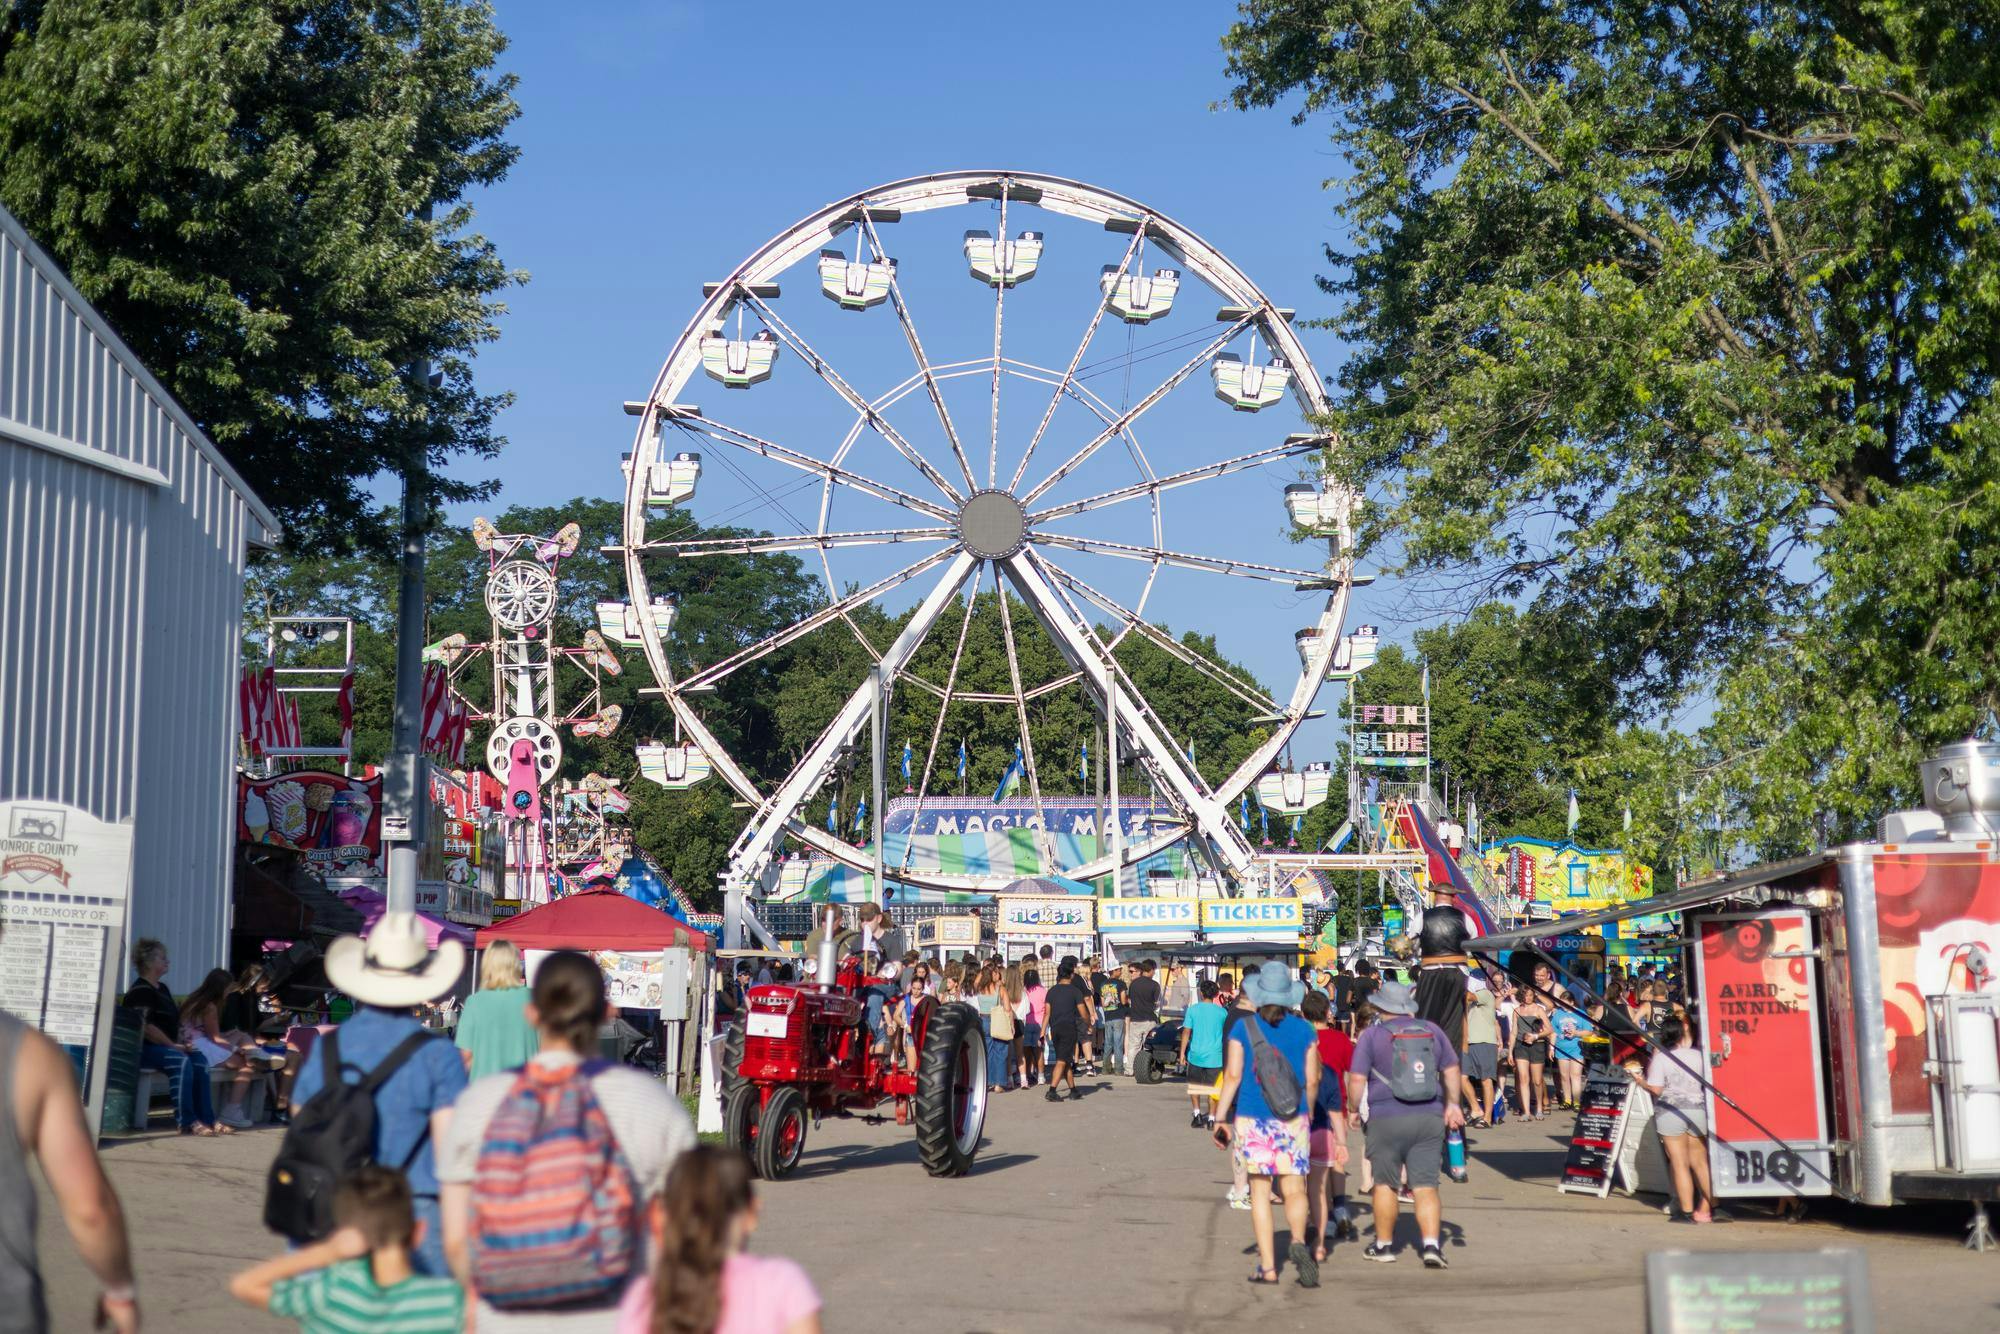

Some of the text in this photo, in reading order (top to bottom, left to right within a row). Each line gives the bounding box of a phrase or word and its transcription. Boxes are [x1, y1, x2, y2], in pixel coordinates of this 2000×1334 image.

[1024, 232, 1034, 241] 9
[1160, 269, 1174, 279] 10
[758, 332, 768, 342] 7
[1273, 358, 1284, 367] 11
[680, 453, 690, 462] 6
[654, 597, 664, 605] 5
[1358, 627, 1373, 636] 13
[1363, 705, 1418, 725] FUN
[1355, 731, 1424, 752] SLIDE
[1309, 762, 1324, 772] 14
[444, 822, 462, 836] CE
[0, 839, 79, 857] ONROE COUNTY
[307, 846, 368, 861] COTTON CANDY
[443, 838, 471, 855] EAM
[790, 852, 800, 860] 3
[1524, 861, 1533, 893] TOWN
[423, 893, 438, 905] POP
[12, 905, 29, 916] OR
[32, 906, 87, 919] MEMORY
[90, 911, 109, 921] OF:
[494, 905, 520, 916] Drinks
[1008, 905, 1083, 924] TICKETS
[1105, 903, 1191, 920] TICKETS
[1209, 904, 1296, 921] TICKETS
[1539, 939, 1594, 949] TO BOOTH
[1719, 983, 1786, 998] AWARD-
[1718, 1000, 1799, 1016] WINNING
[1720, 1017, 1759, 1035] BBQ!
[1610, 1086, 1629, 1095] MENU
[1734, 1150, 1806, 1188] BBQ
